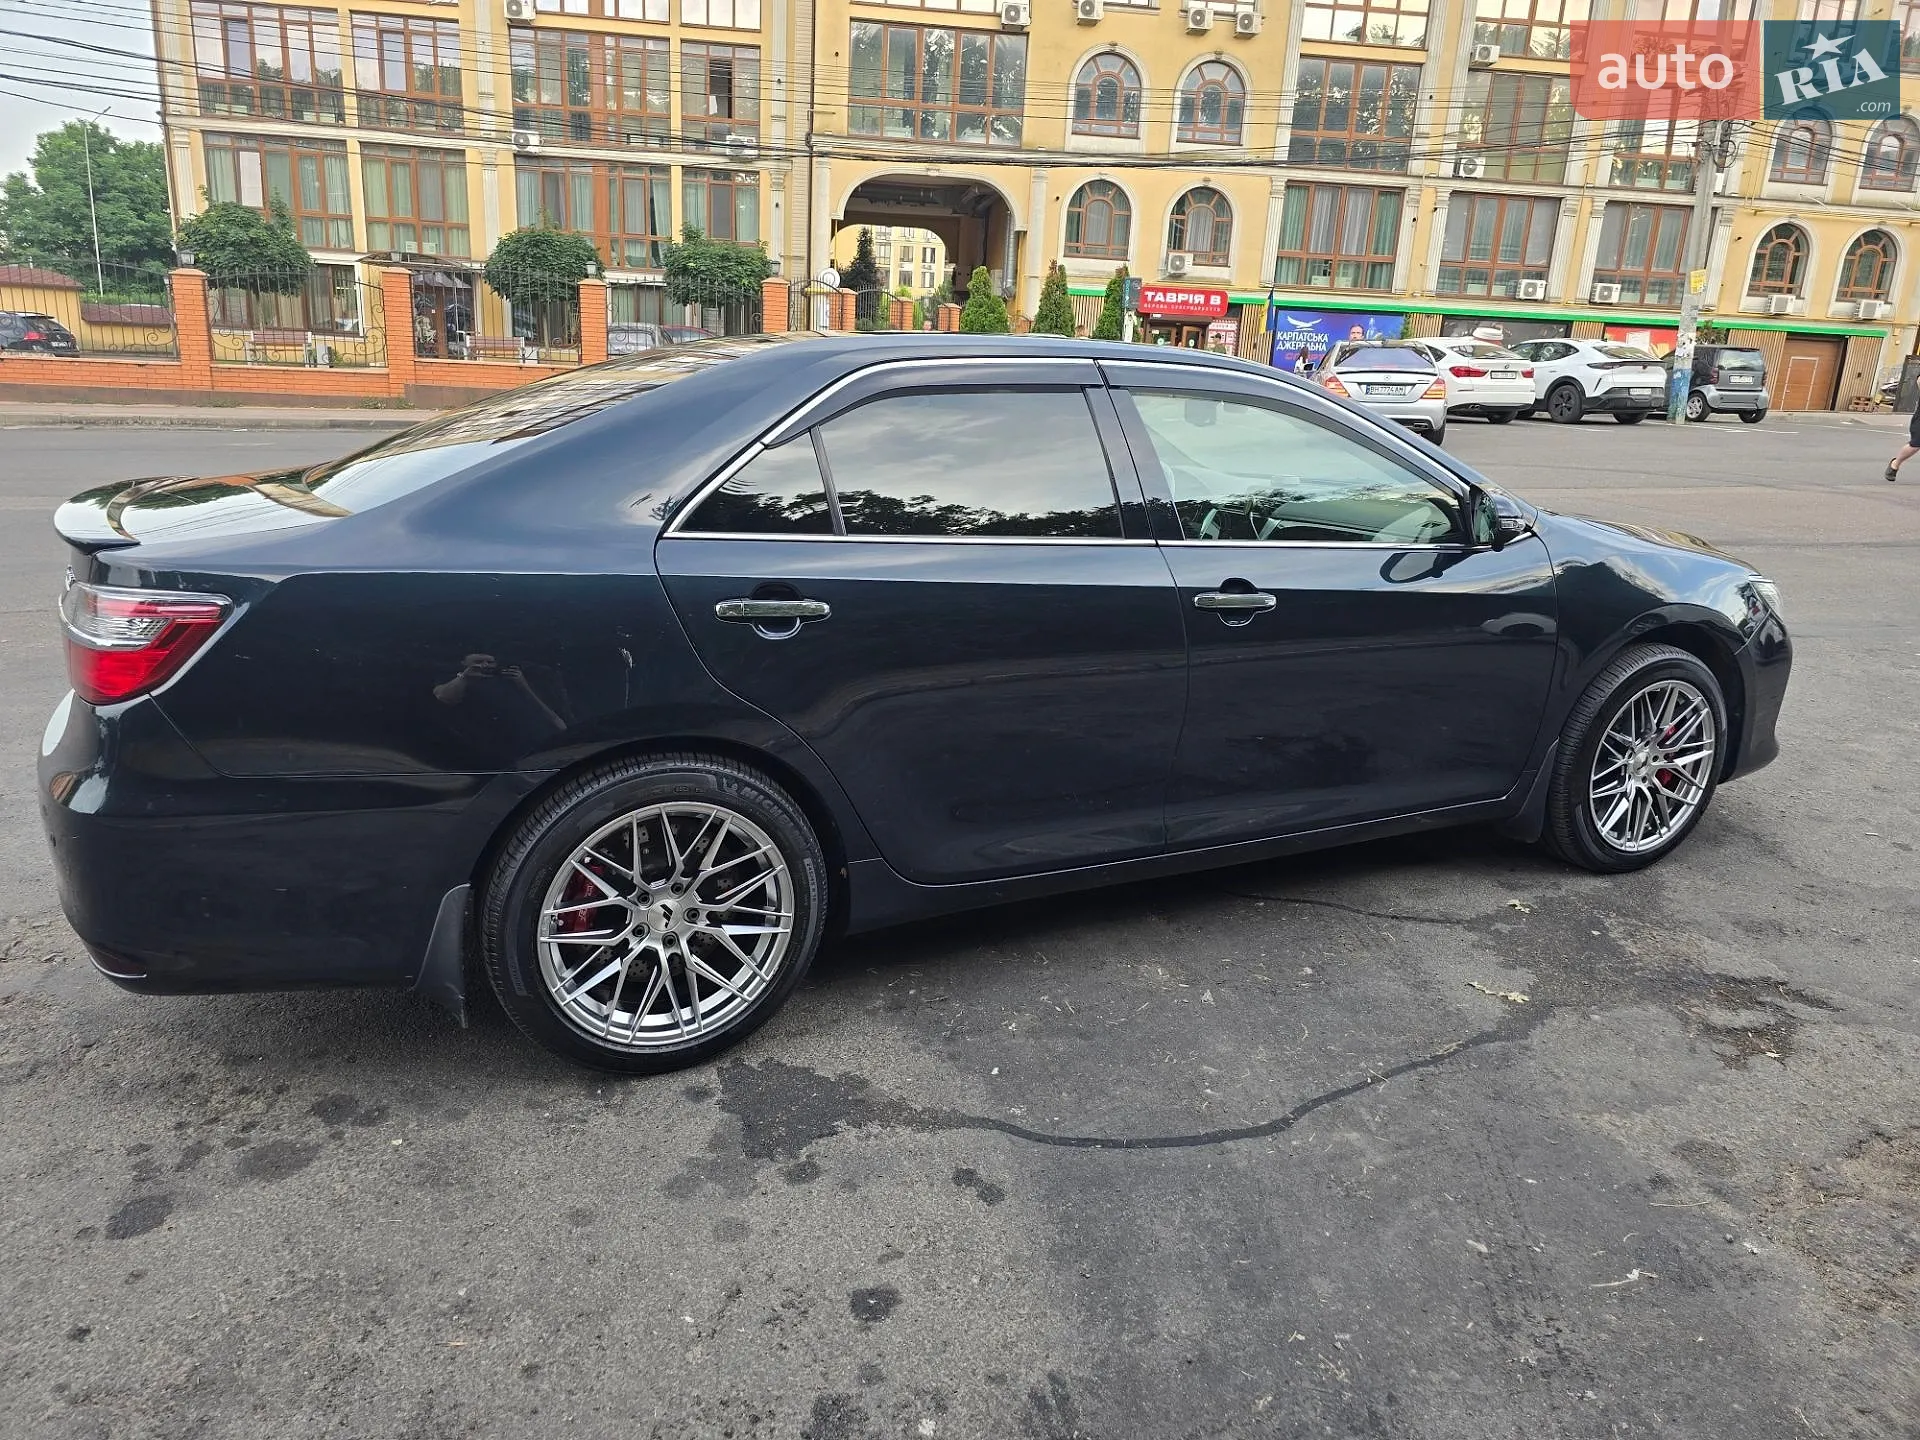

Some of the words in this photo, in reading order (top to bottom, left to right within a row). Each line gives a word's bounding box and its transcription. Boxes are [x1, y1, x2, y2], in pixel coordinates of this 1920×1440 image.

[1144, 291, 1205, 304] ТАВРІЯ
[1209, 294, 1221, 305] В
[1276, 331, 1329, 343] КАРПАТСЬКА
